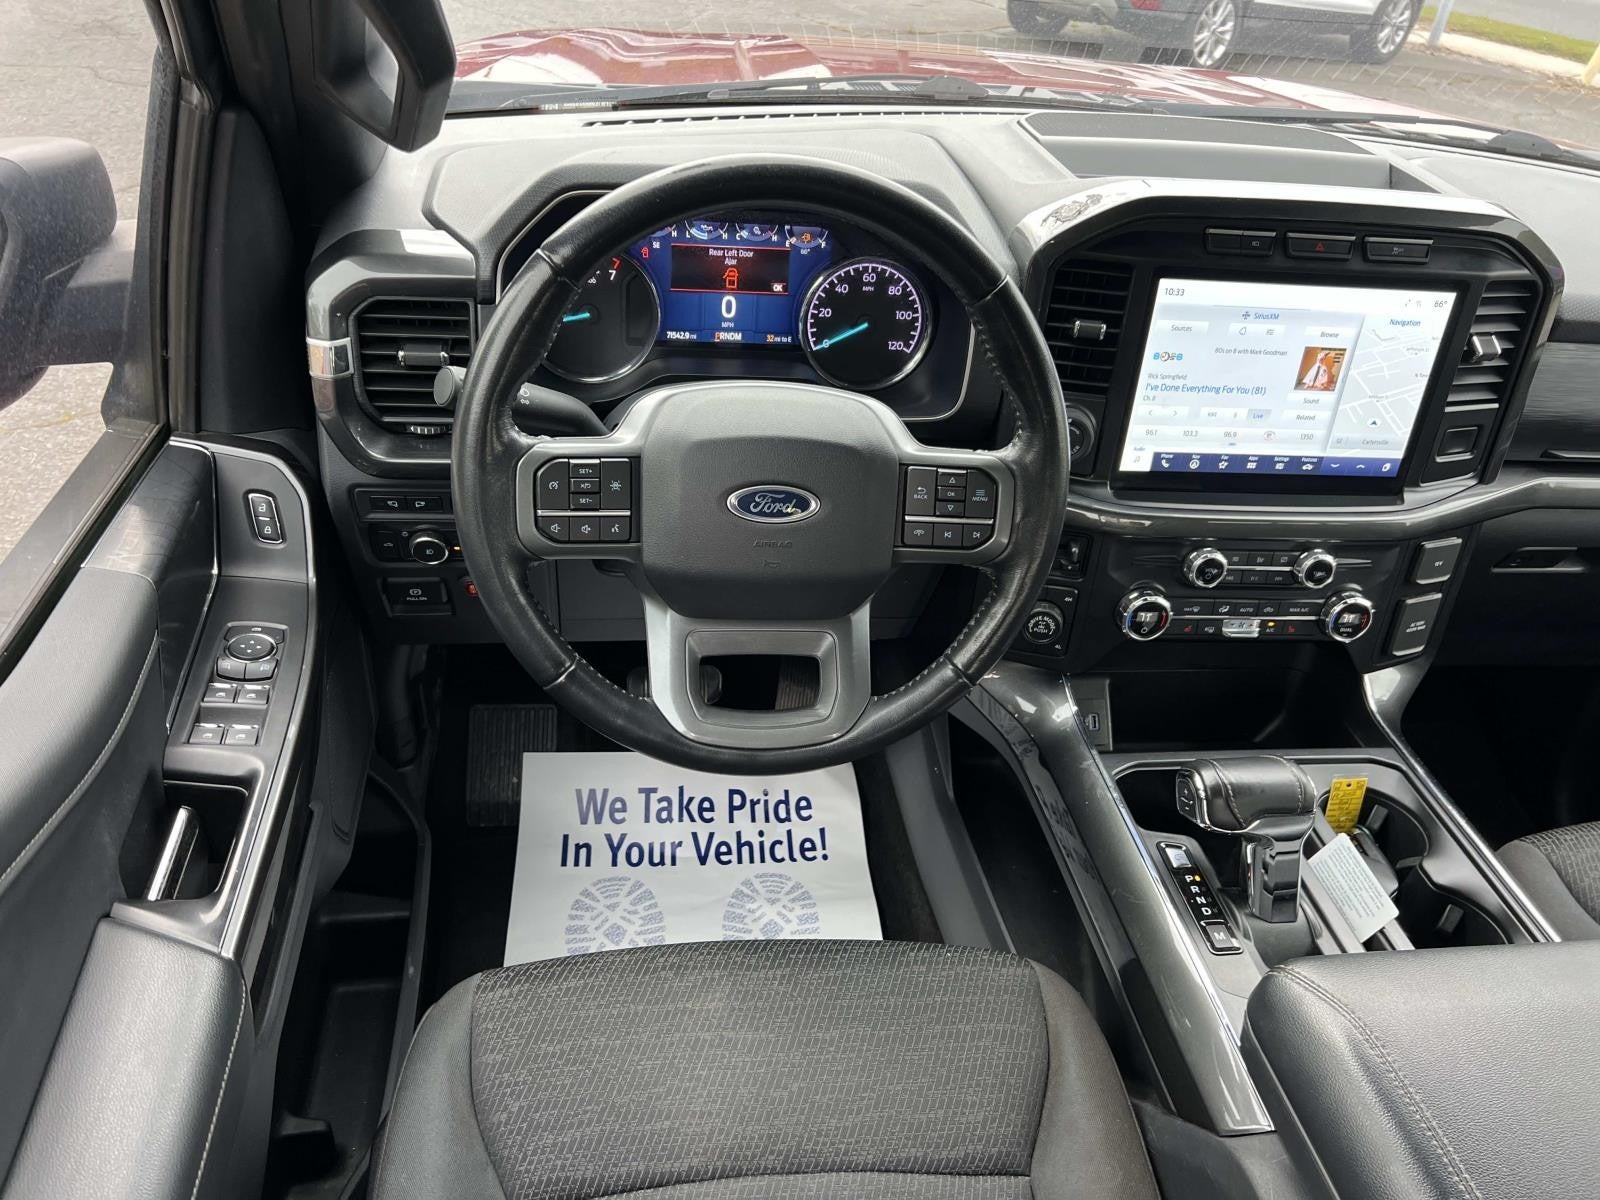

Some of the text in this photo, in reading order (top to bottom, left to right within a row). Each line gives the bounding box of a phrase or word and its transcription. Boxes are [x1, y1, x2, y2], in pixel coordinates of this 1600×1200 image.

[652, 241, 661, 249] SE
[709, 248, 754, 258] Rear Left Door
[724, 257, 738, 266] Ajar
[862, 275, 876, 283] 60
[772, 284, 784, 292] OK
[835, 286, 849, 294] 40
[888, 285, 902, 296] 80
[1164, 287, 1185, 297] 10:33
[721, 295, 737, 319] 0
[818, 307, 832, 318] 20
[895, 310, 913, 321] 100
[1253, 312, 1281, 320] SiriusXM
[1389, 318, 1421, 328] Navigation
[1170, 324, 1193, 333] Sources
[666, 331, 690, 340] 71542.9
[766, 333, 775, 342] 32
[1319, 331, 1340, 339] Browse
[887, 340, 904, 351] 120
[1145, 383, 1267, 397] I've Done Everything For You (81)
[1252, 412, 1264, 420] Live
[1295, 414, 1316, 422] Related
[749, 492, 802, 514] Ford
[575, 785, 814, 826] We Take Pride
[560, 826, 830, 869] In Your Vehicle!
[1184, 875, 1194, 883] P
[1190, 885, 1200, 894] R
[1196, 896, 1207, 905] N
[1201, 907, 1212, 916] D
[1213, 932, 1227, 941] M
